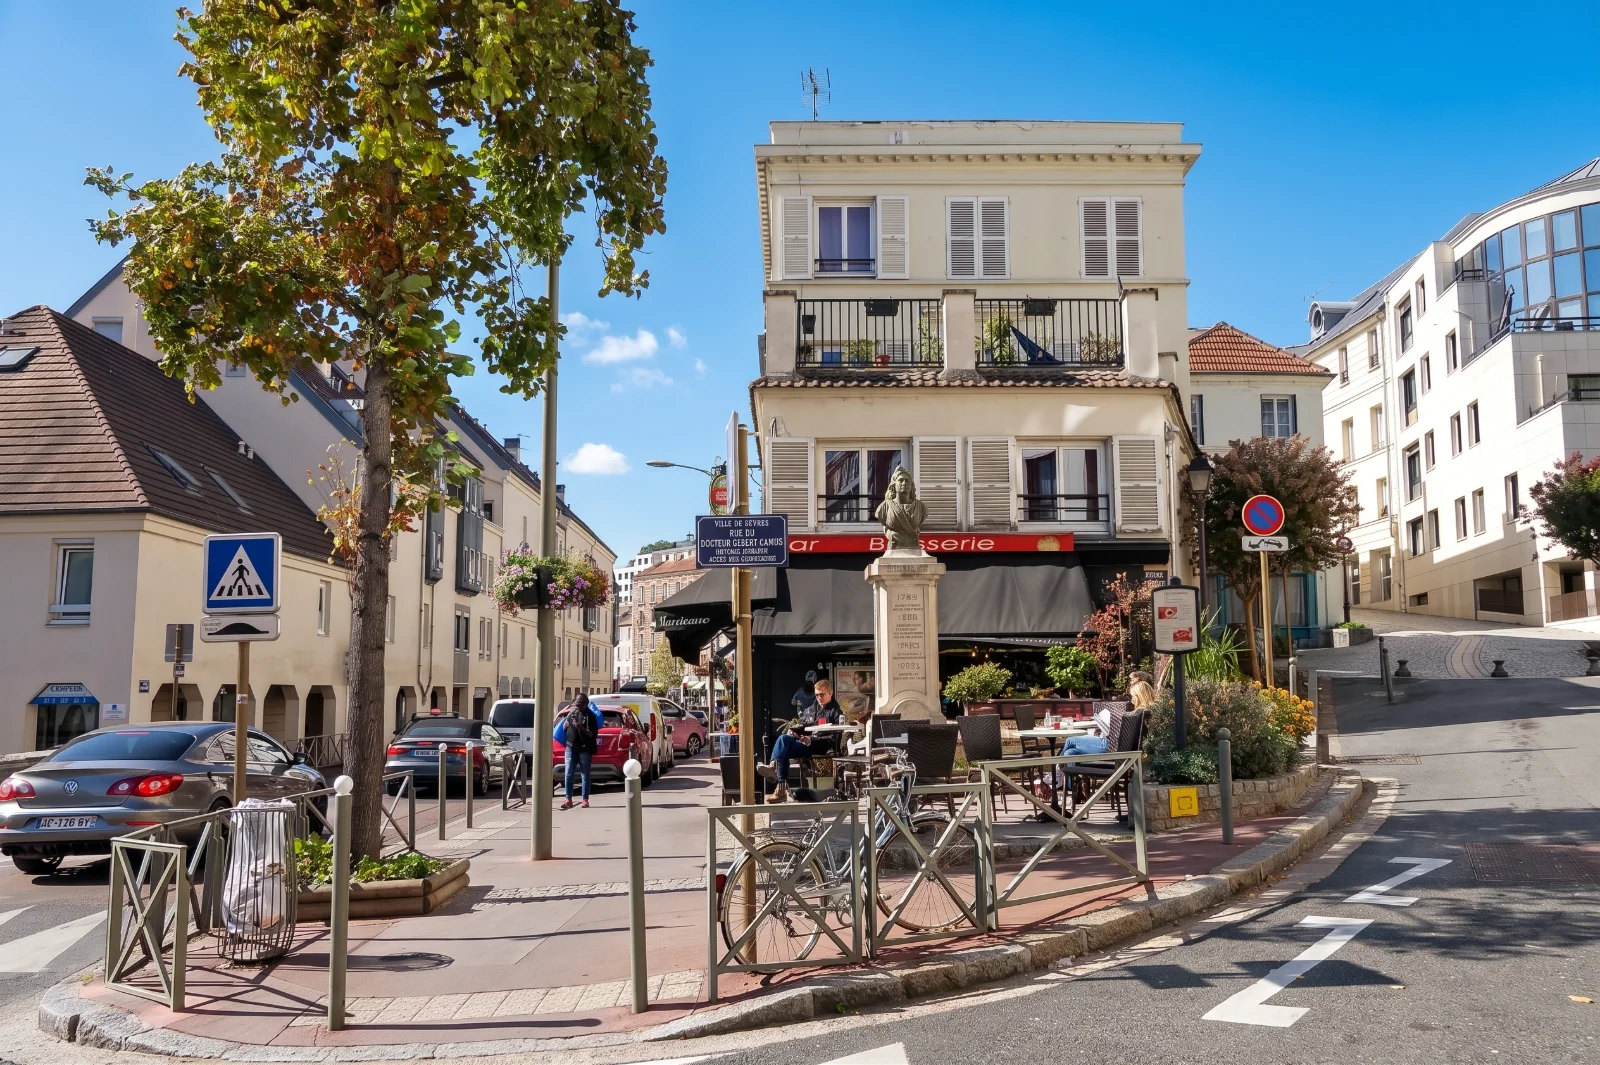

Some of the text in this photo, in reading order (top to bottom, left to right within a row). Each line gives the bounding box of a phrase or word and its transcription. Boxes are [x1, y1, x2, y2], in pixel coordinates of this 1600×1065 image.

[729, 528, 755, 537] RUE DU
[700, 539, 731, 548] DOCTEUR
[759, 537, 783, 546] CAMUS
[789, 537, 995, 551] ar Bsserie
[897, 593, 918, 601] 1789
